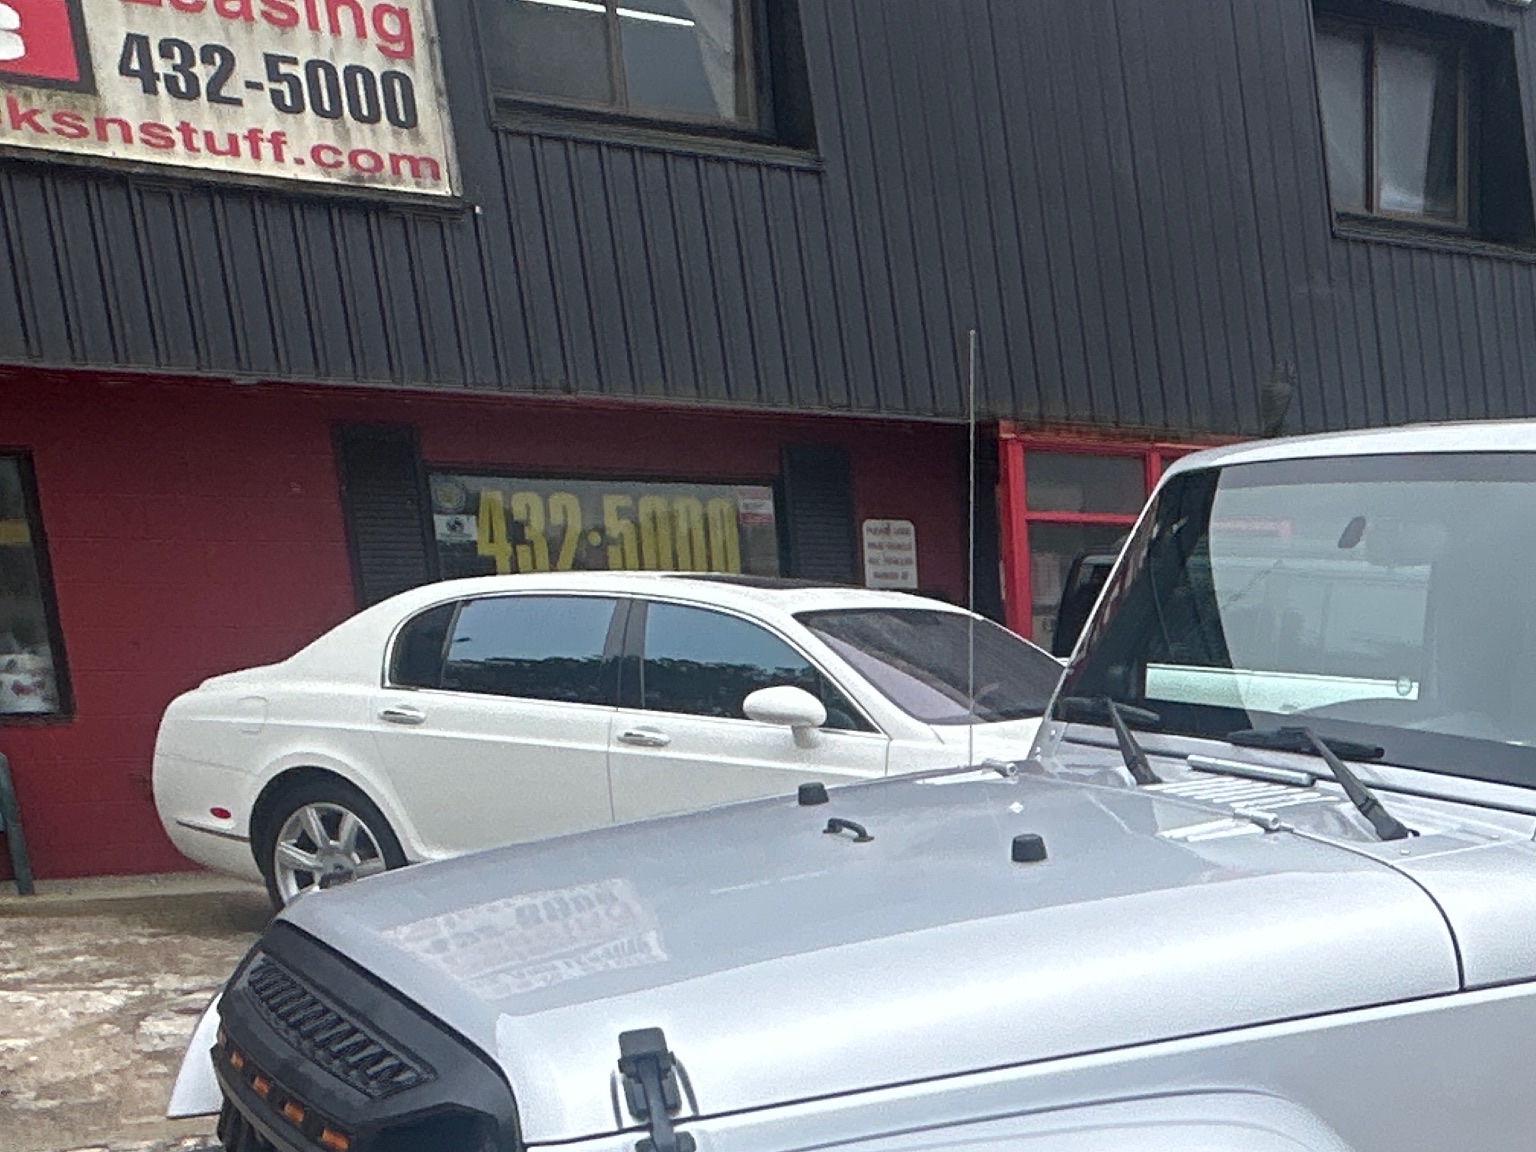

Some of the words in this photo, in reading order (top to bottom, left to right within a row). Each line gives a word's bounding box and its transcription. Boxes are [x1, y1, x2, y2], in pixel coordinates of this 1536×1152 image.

[120, 0, 415, 59] asing
[118, 32, 419, 130] 432-5000
[0, 95, 442, 181] ksnstuff.com
